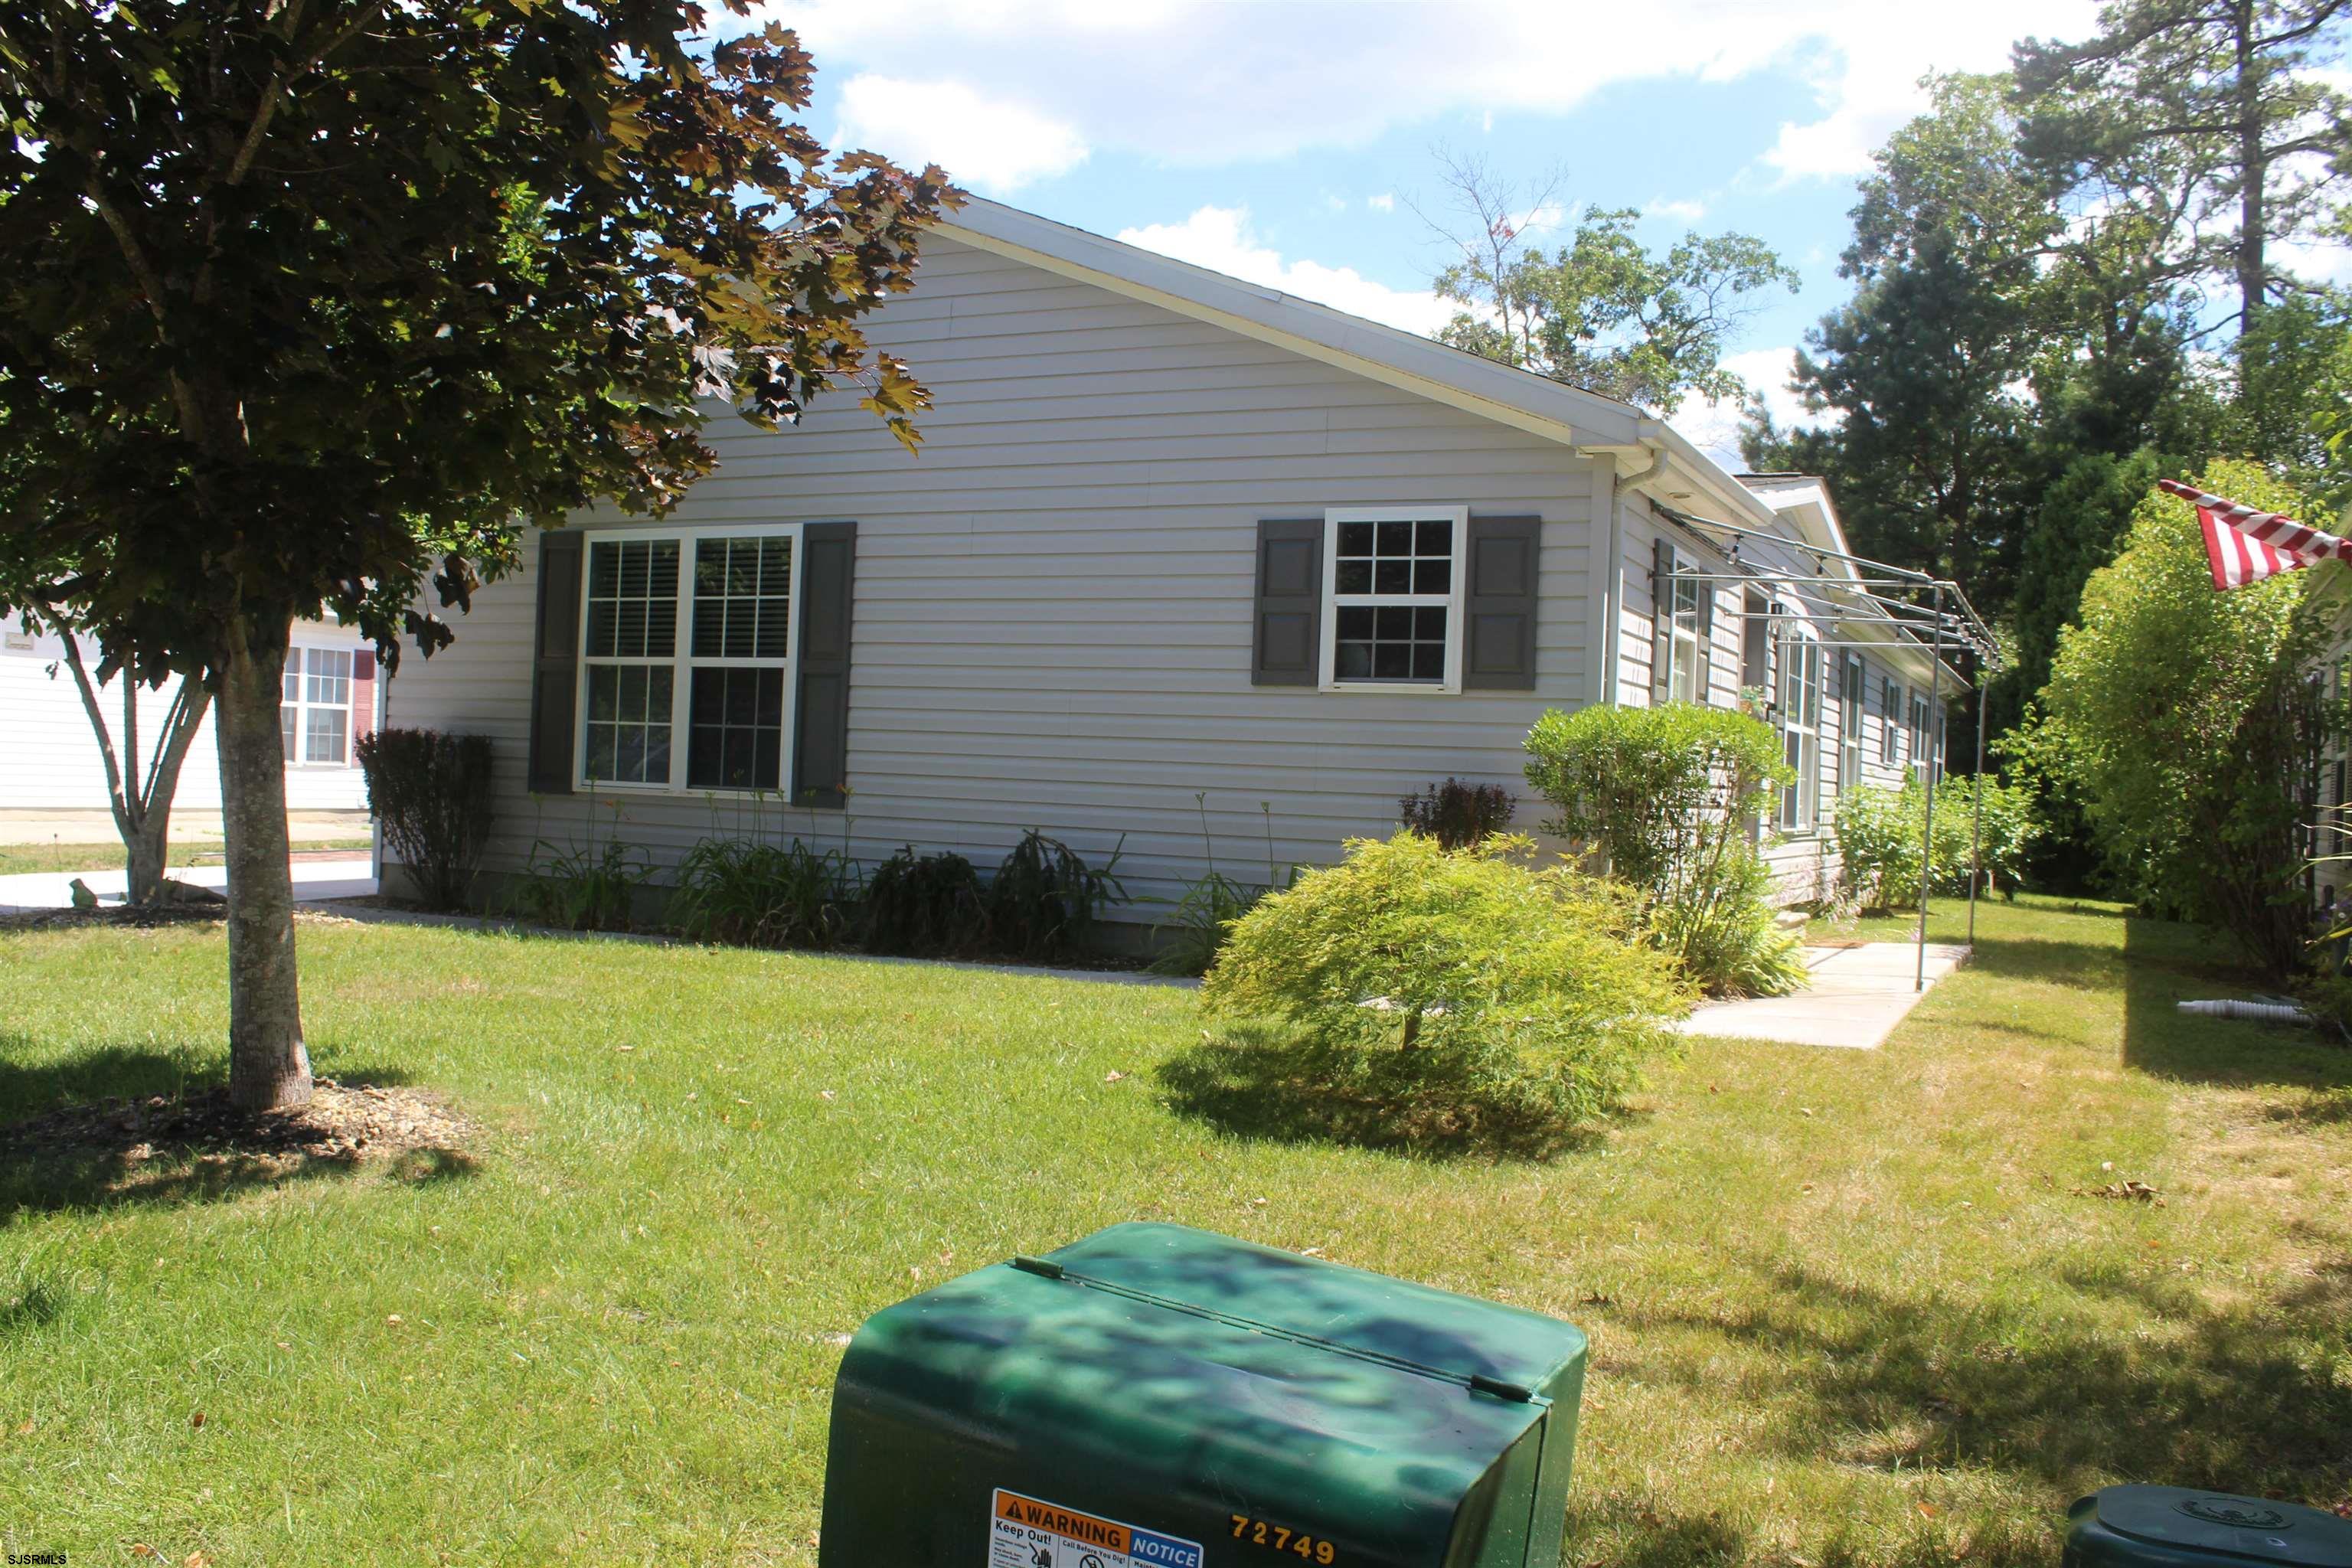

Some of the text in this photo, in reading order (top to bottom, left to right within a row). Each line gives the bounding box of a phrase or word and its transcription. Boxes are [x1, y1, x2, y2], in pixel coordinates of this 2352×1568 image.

[995, 1520, 1024, 1538] Keep
[1027, 1530, 1051, 1545] Out!
[1027, 1505, 1120, 1548] WARNING
[1232, 1514, 1334, 1564] 72749
[1063, 1540, 1125, 1564] Call Before You Dig!
[1133, 1537, 1197, 1567] NOTICE
